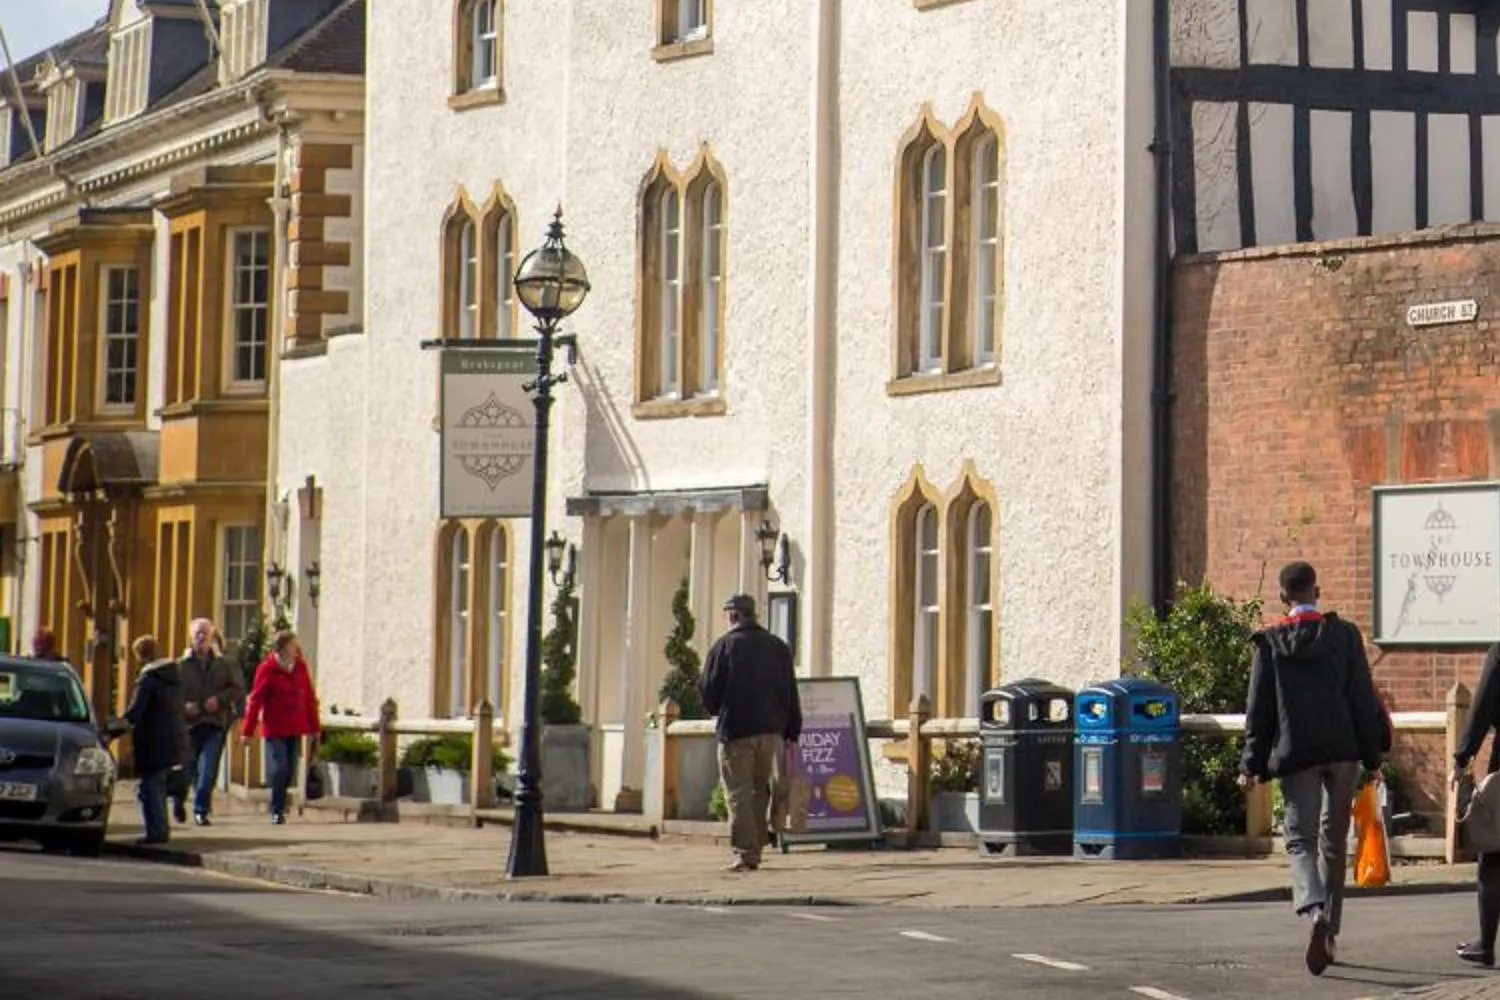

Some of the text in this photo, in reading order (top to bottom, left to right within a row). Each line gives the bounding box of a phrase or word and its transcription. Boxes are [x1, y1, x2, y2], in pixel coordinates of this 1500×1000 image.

[1409, 304, 1456, 323] CHURCH
[1389, 550, 1493, 569] TOWNHOUSE
[798, 732, 841, 748] RIDAY
[803, 747, 835, 763] FIZZ
